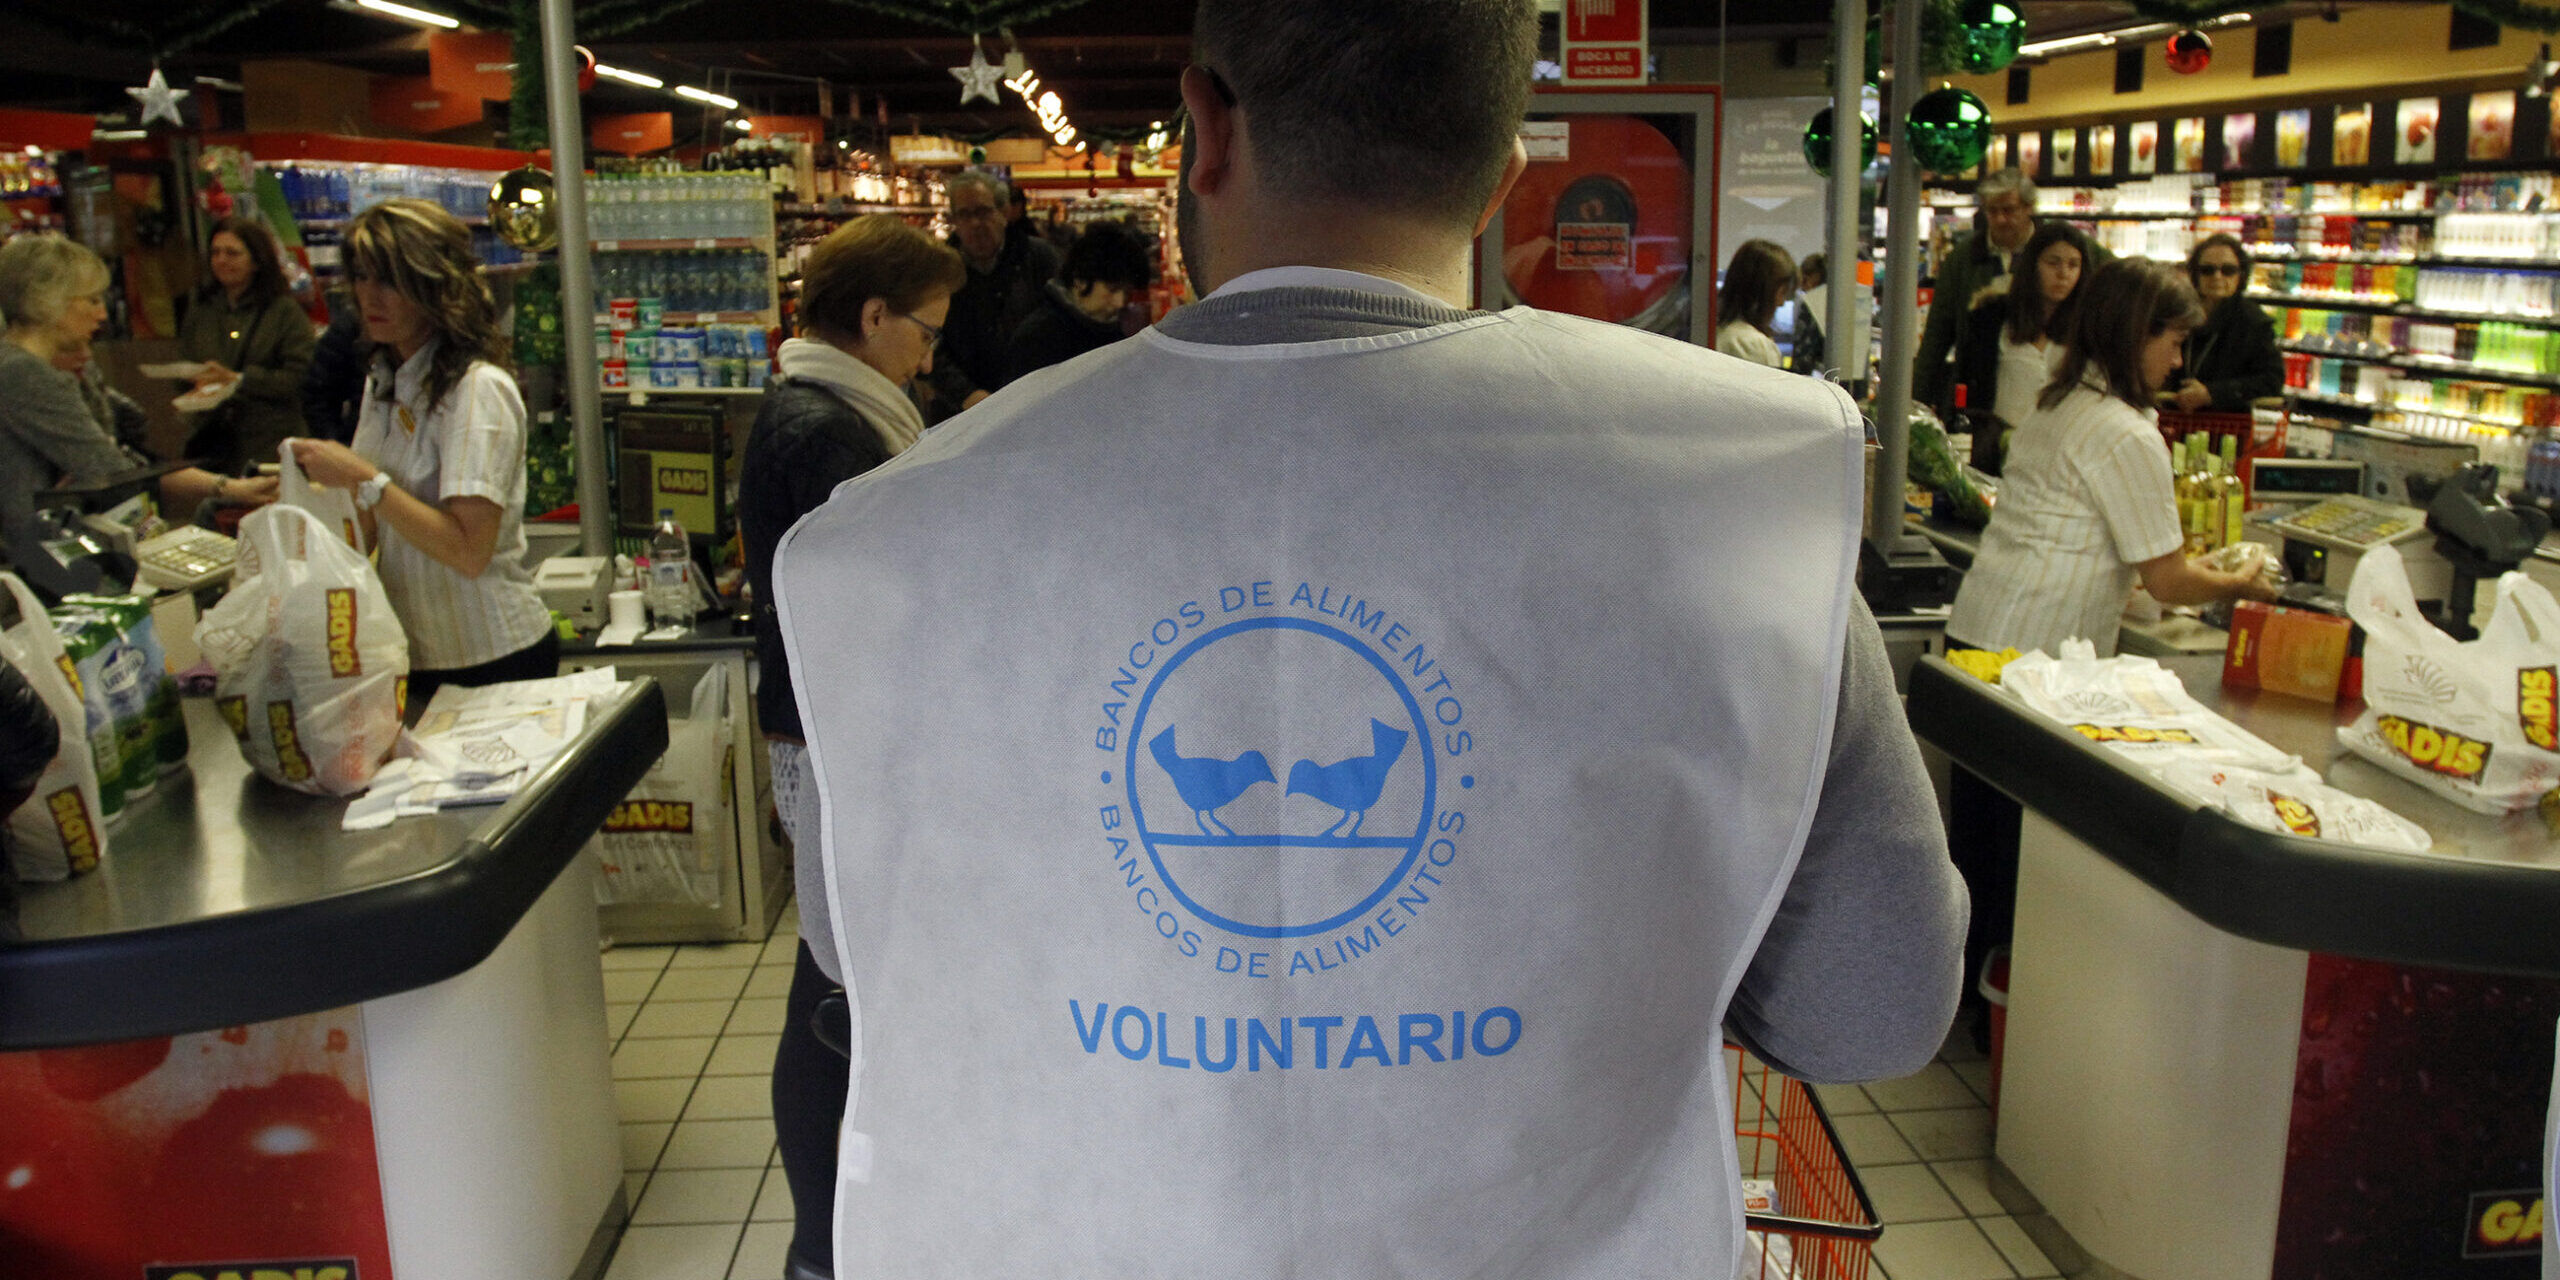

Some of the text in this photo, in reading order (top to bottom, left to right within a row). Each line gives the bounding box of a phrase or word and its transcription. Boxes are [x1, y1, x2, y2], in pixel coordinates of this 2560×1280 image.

[1574, 65, 1634, 75] INCENDIO
[1577, 51, 1631, 61] BOCA DE
[660, 470, 706, 492] GADIS
[327, 589, 355, 674] GADIS
[1095, 581, 1473, 756] BANCOS DE ALIMENTOS
[1100, 804, 1465, 979] BANCOS DE ALIMENTOS
[1069, 999, 1522, 1073] VOLUNTARIO
